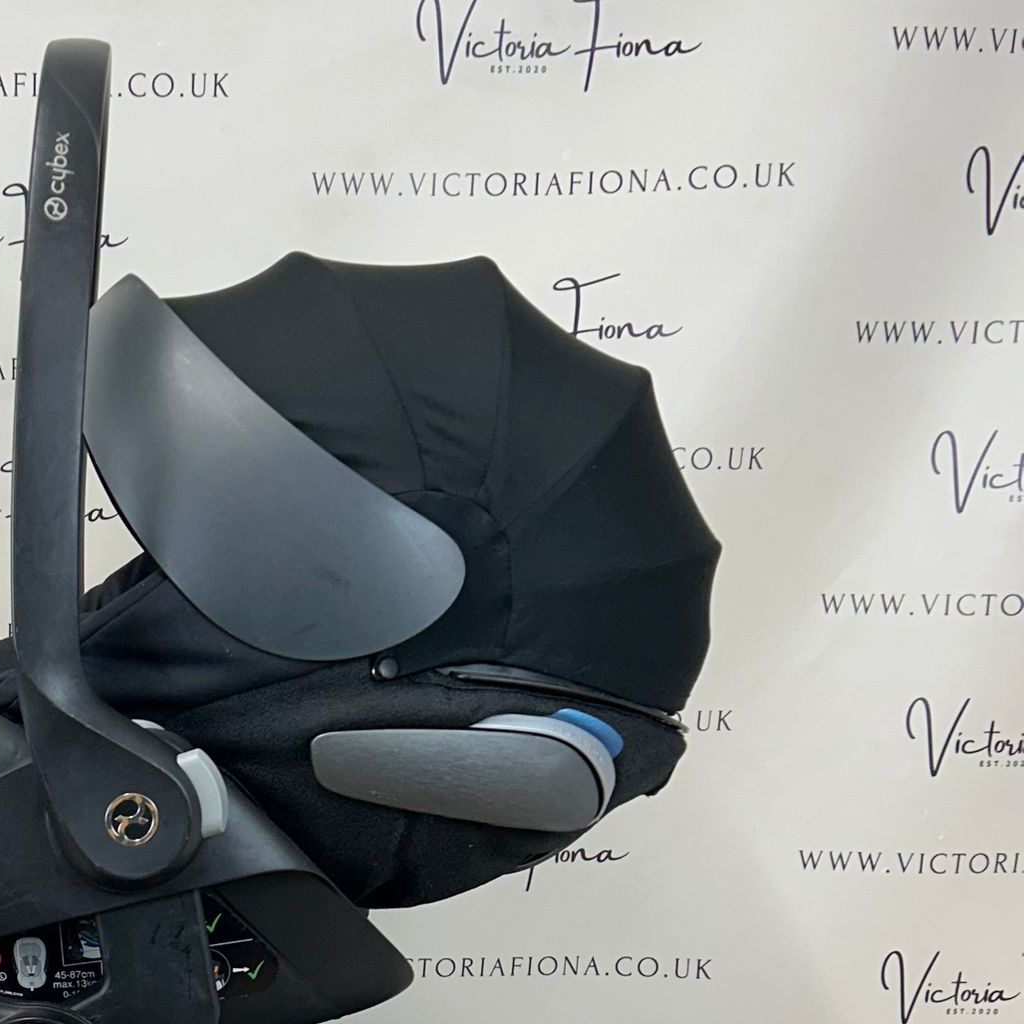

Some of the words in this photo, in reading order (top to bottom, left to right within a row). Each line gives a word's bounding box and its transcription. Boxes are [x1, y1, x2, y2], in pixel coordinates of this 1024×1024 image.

[415, 0, 572, 86] Victoria
[489, 64, 547, 75] EST.2020
[45, 131, 74, 195] cybex
[311, 161, 796, 198] WWW.VICTORIAFIONA.CO.UK
[552, 272, 683, 338] Fiona
[945, 1007, 999, 1016] EST.2020
